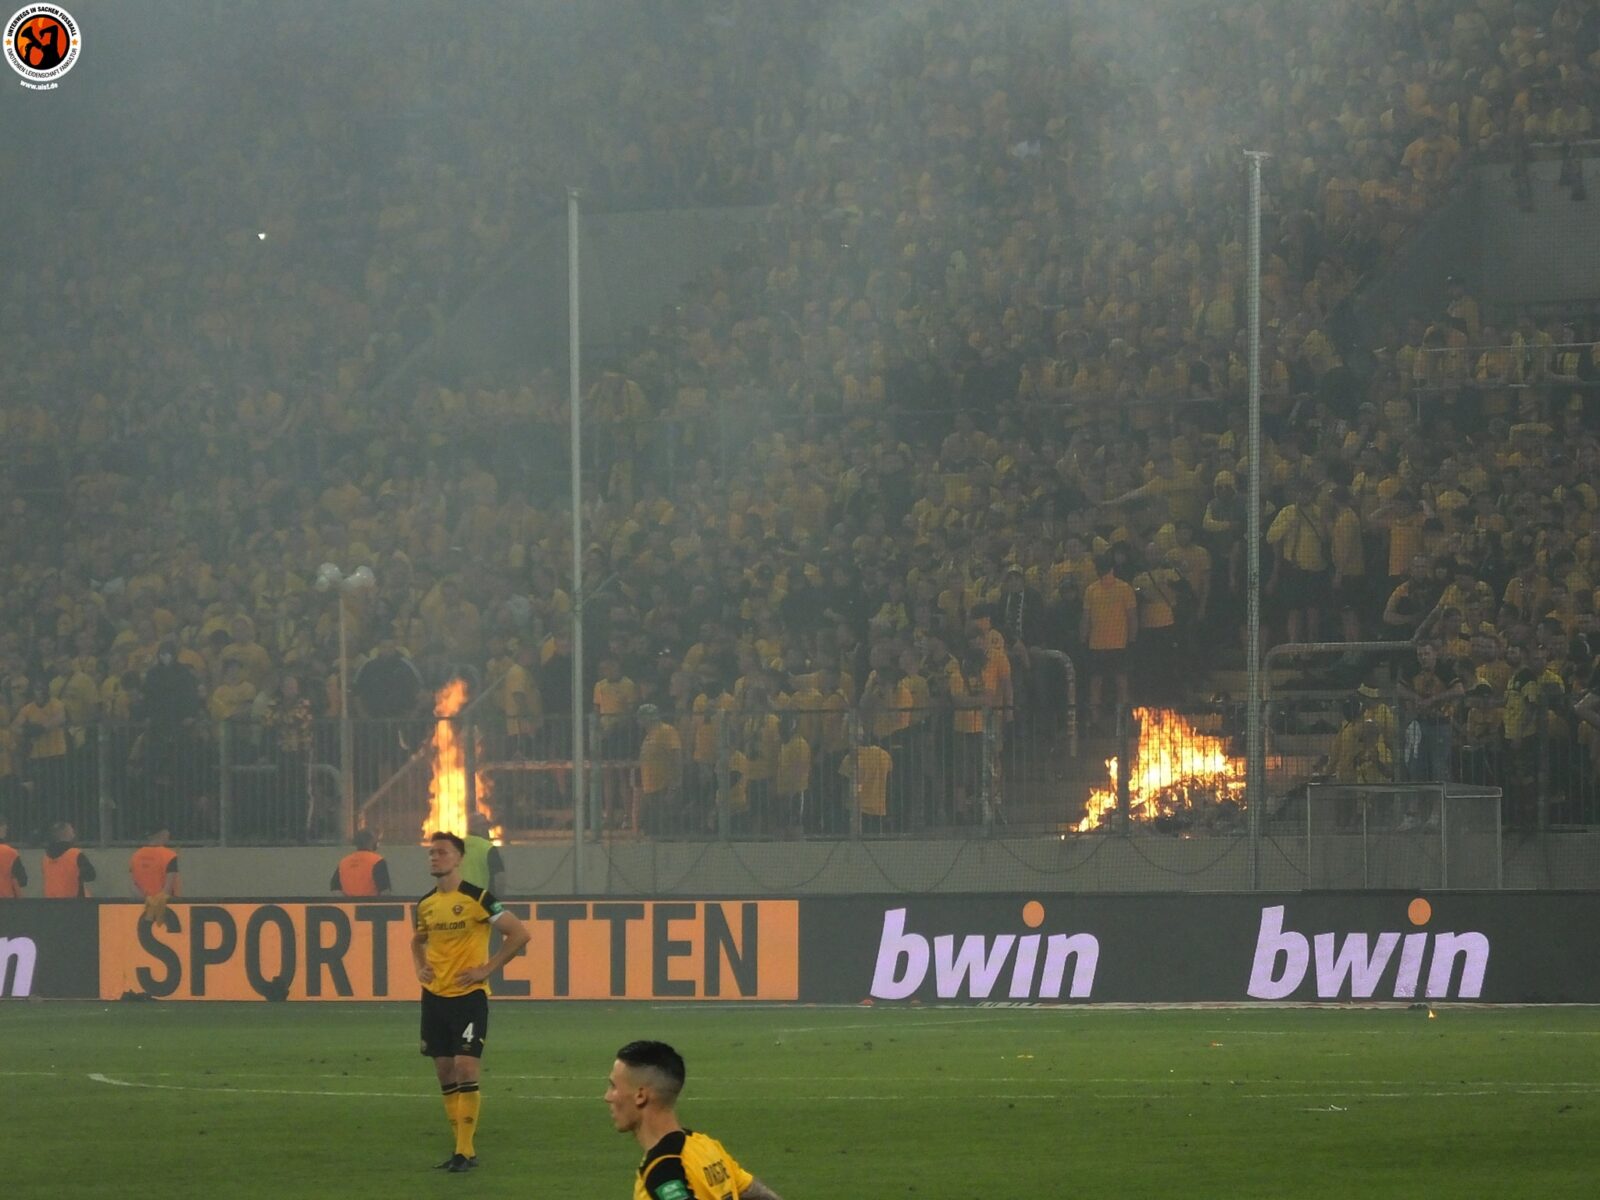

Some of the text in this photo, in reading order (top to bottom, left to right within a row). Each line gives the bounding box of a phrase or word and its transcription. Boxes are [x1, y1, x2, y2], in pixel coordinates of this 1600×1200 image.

[136, 903, 759, 998] SPORTETTEN
[869, 900, 1100, 1000] bwin
[1246, 897, 1490, 1000] bwin
[462, 1022, 474, 1043] 4
